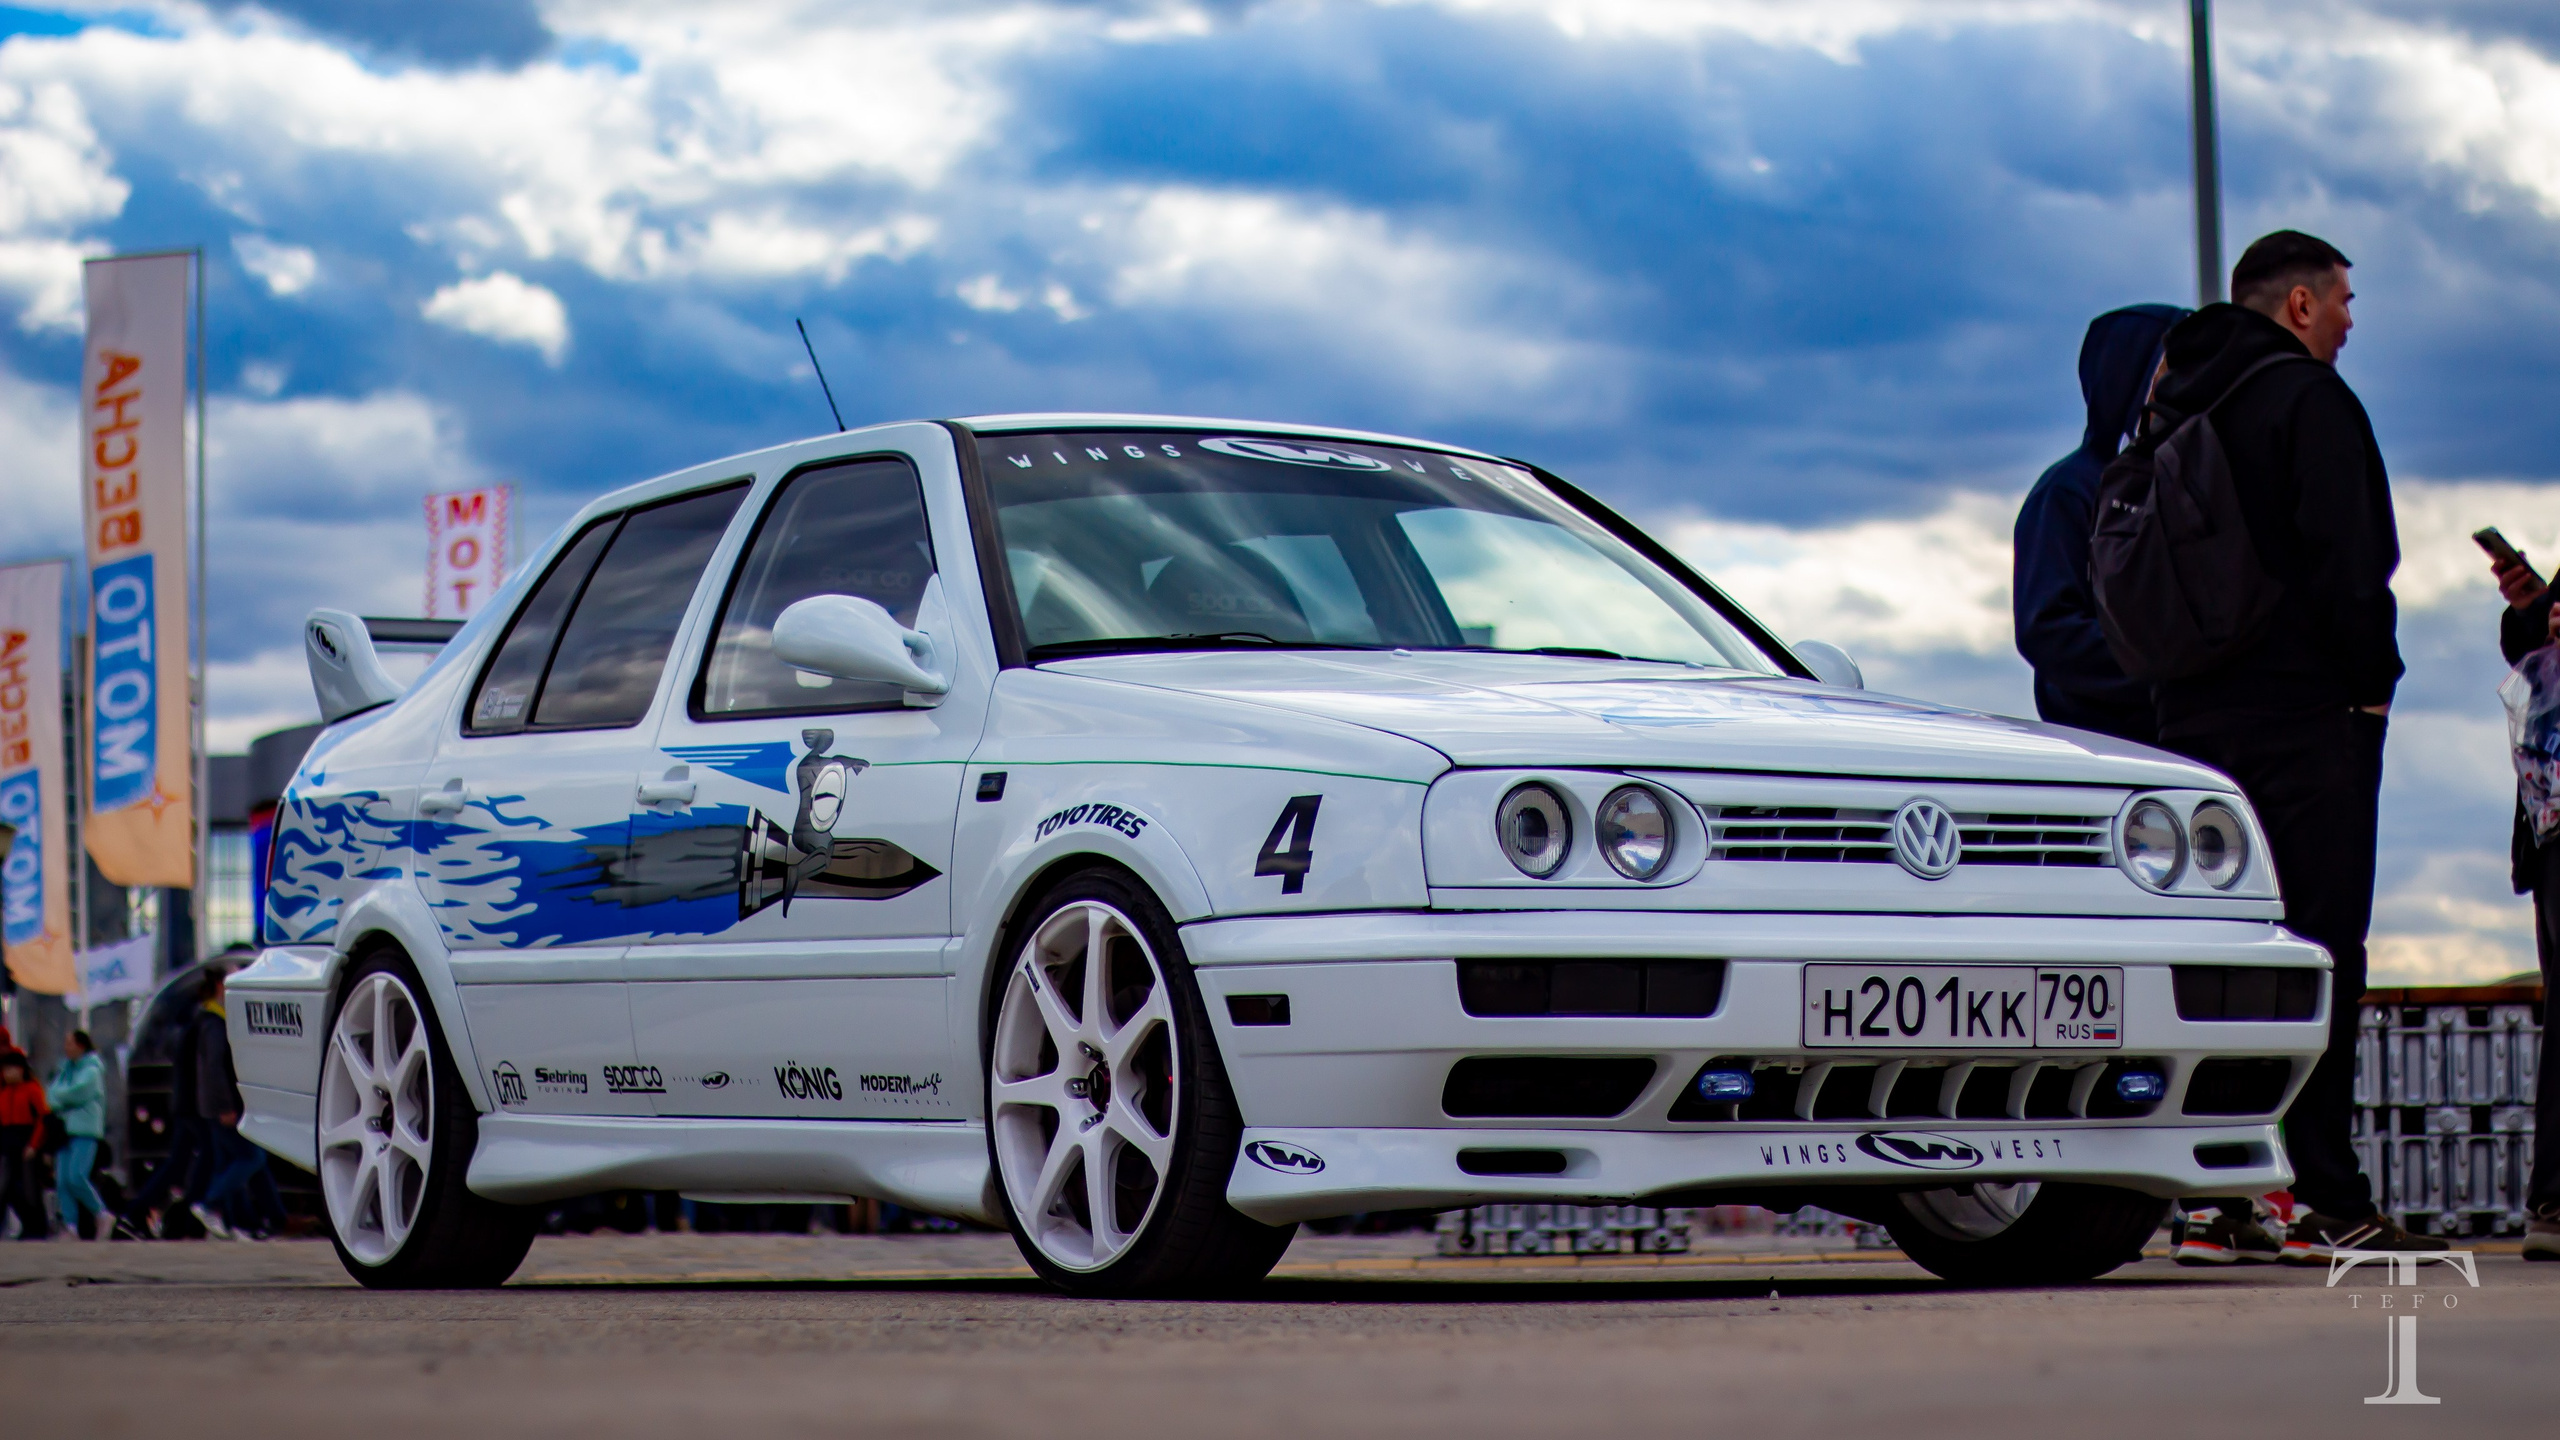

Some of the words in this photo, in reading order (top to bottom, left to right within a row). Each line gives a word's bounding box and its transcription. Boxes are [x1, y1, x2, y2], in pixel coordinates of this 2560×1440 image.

[1008, 444, 1181, 468] WINGS
[1402, 459, 1514, 489] WES
[1034, 804, 1090, 843] TOYO
[1085, 803, 1148, 839] TIRES
[1254, 794, 1323, 894] 4
[2040, 973, 2109, 1020] 790
[2056, 1023, 2091, 1040] RUS
[535, 1068, 588, 1093] Sebring
[603, 1065, 663, 1094] sparco
[774, 1060, 843, 1100] KÖNIG
[1760, 1143, 1847, 1165] WINGS
[1990, 1139, 2063, 1159] WEST
